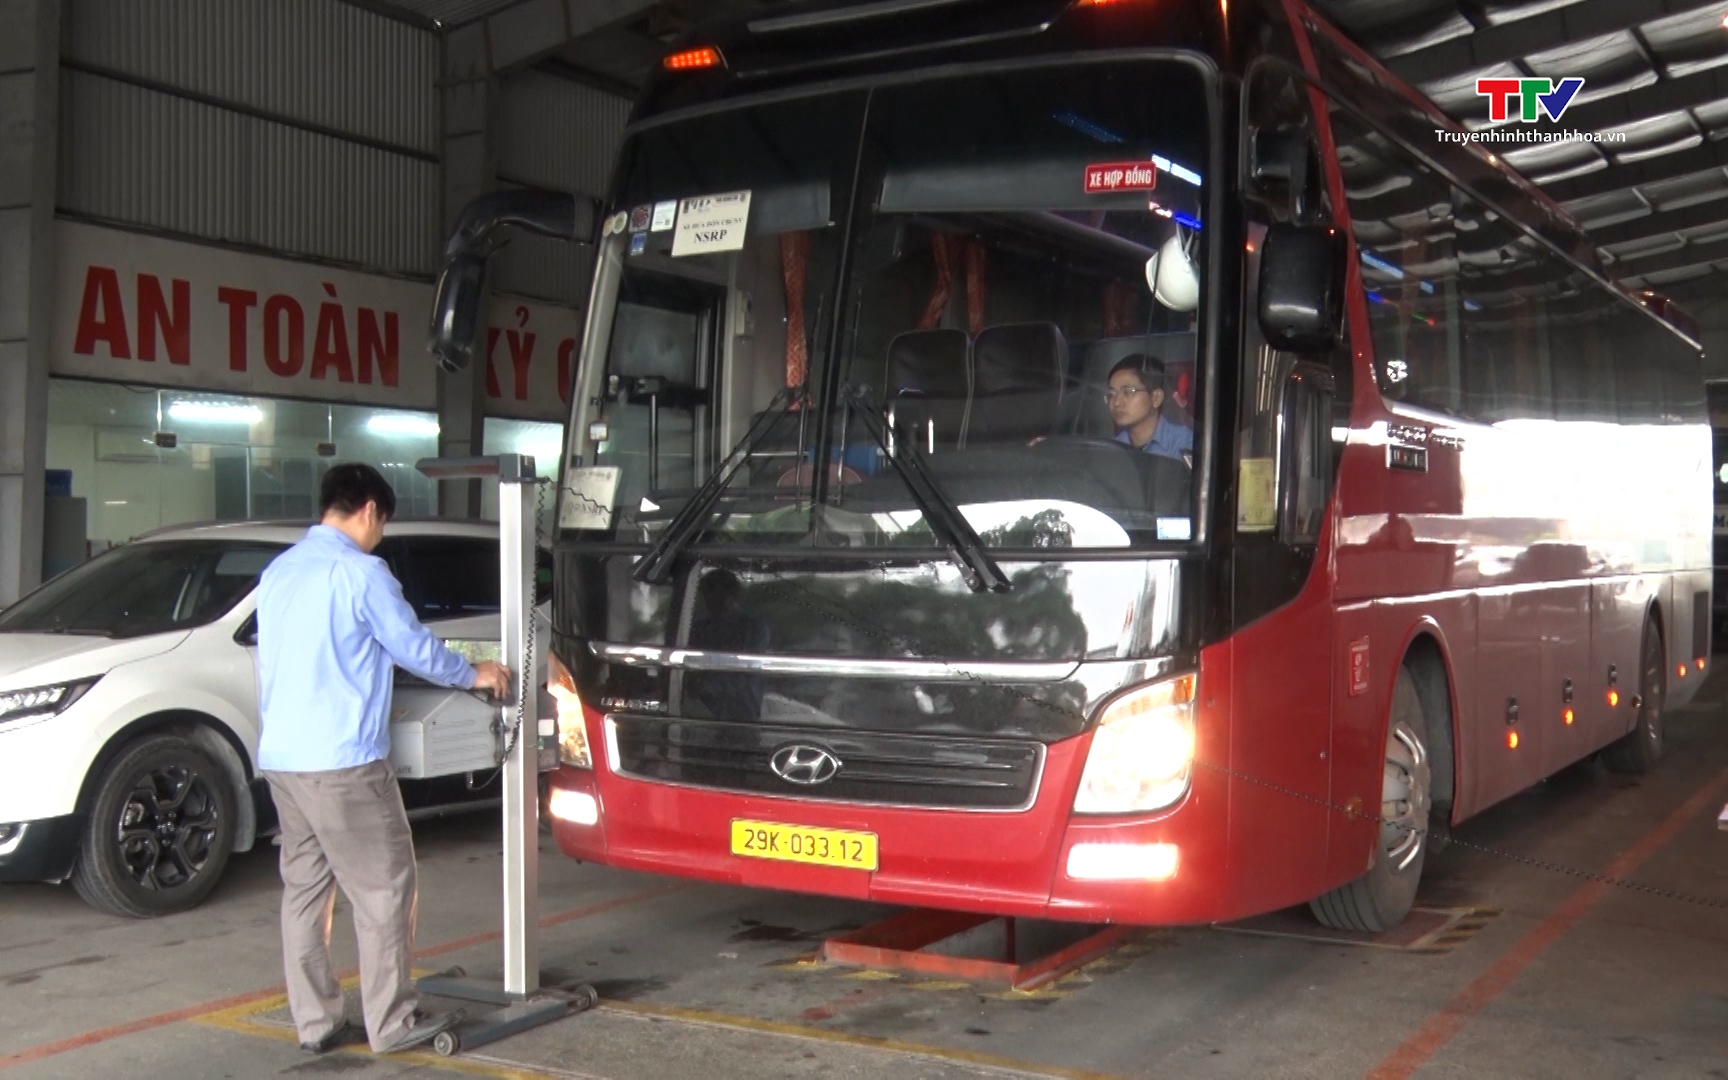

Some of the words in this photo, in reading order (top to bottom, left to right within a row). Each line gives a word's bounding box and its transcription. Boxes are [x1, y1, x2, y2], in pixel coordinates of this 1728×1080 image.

[1089, 171, 1102, 188] XE
[1104, 169, 1123, 190] HỢP
[693, 229, 728, 244] NSRP
[74, 265, 191, 366] AN
[218, 281, 399, 388] TOÀN
[487, 305, 537, 401] KỶ
[744, 828, 863, 862] 29K-033.12
